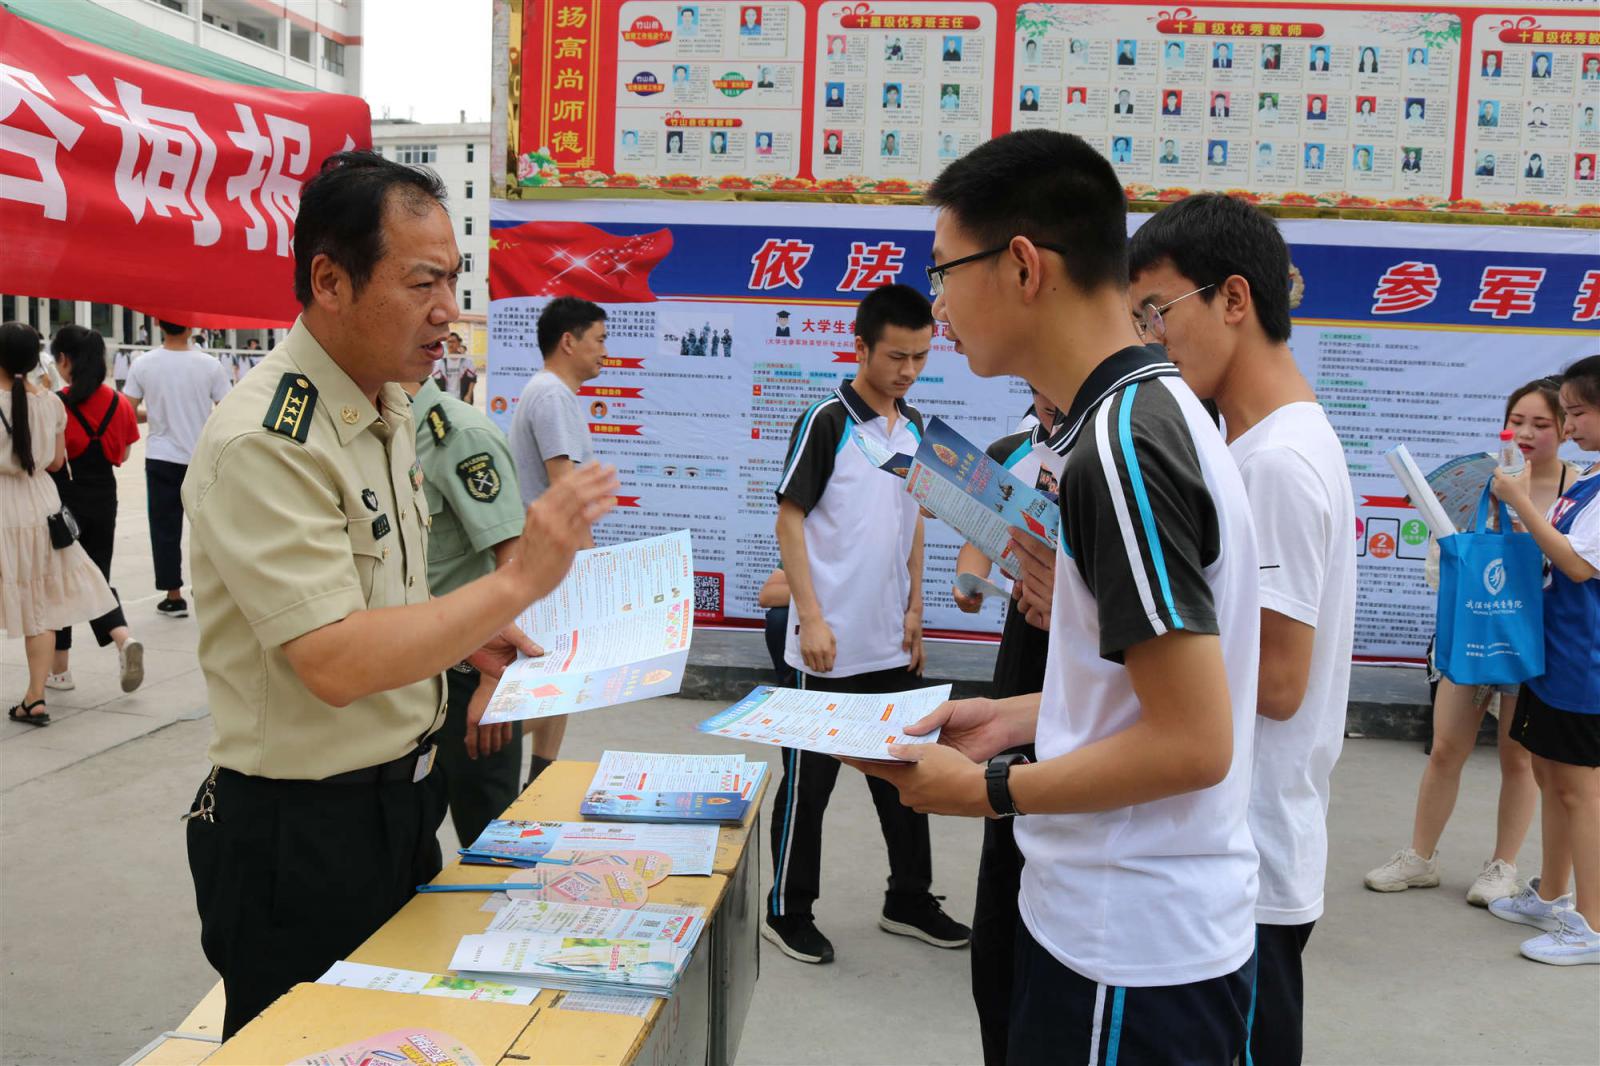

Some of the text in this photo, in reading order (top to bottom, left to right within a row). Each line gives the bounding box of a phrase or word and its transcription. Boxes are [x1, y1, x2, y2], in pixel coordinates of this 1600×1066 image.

[857, 15, 964, 29] 十星级优秀班主任
[1173, 21, 1302, 37] 十星级优秀教师
[551, 6, 588, 154] 扬高尚师德
[0, 63, 355, 257] 咨询报
[1410, 520, 1421, 535] 3
[1377, 533, 1389, 549] 2
